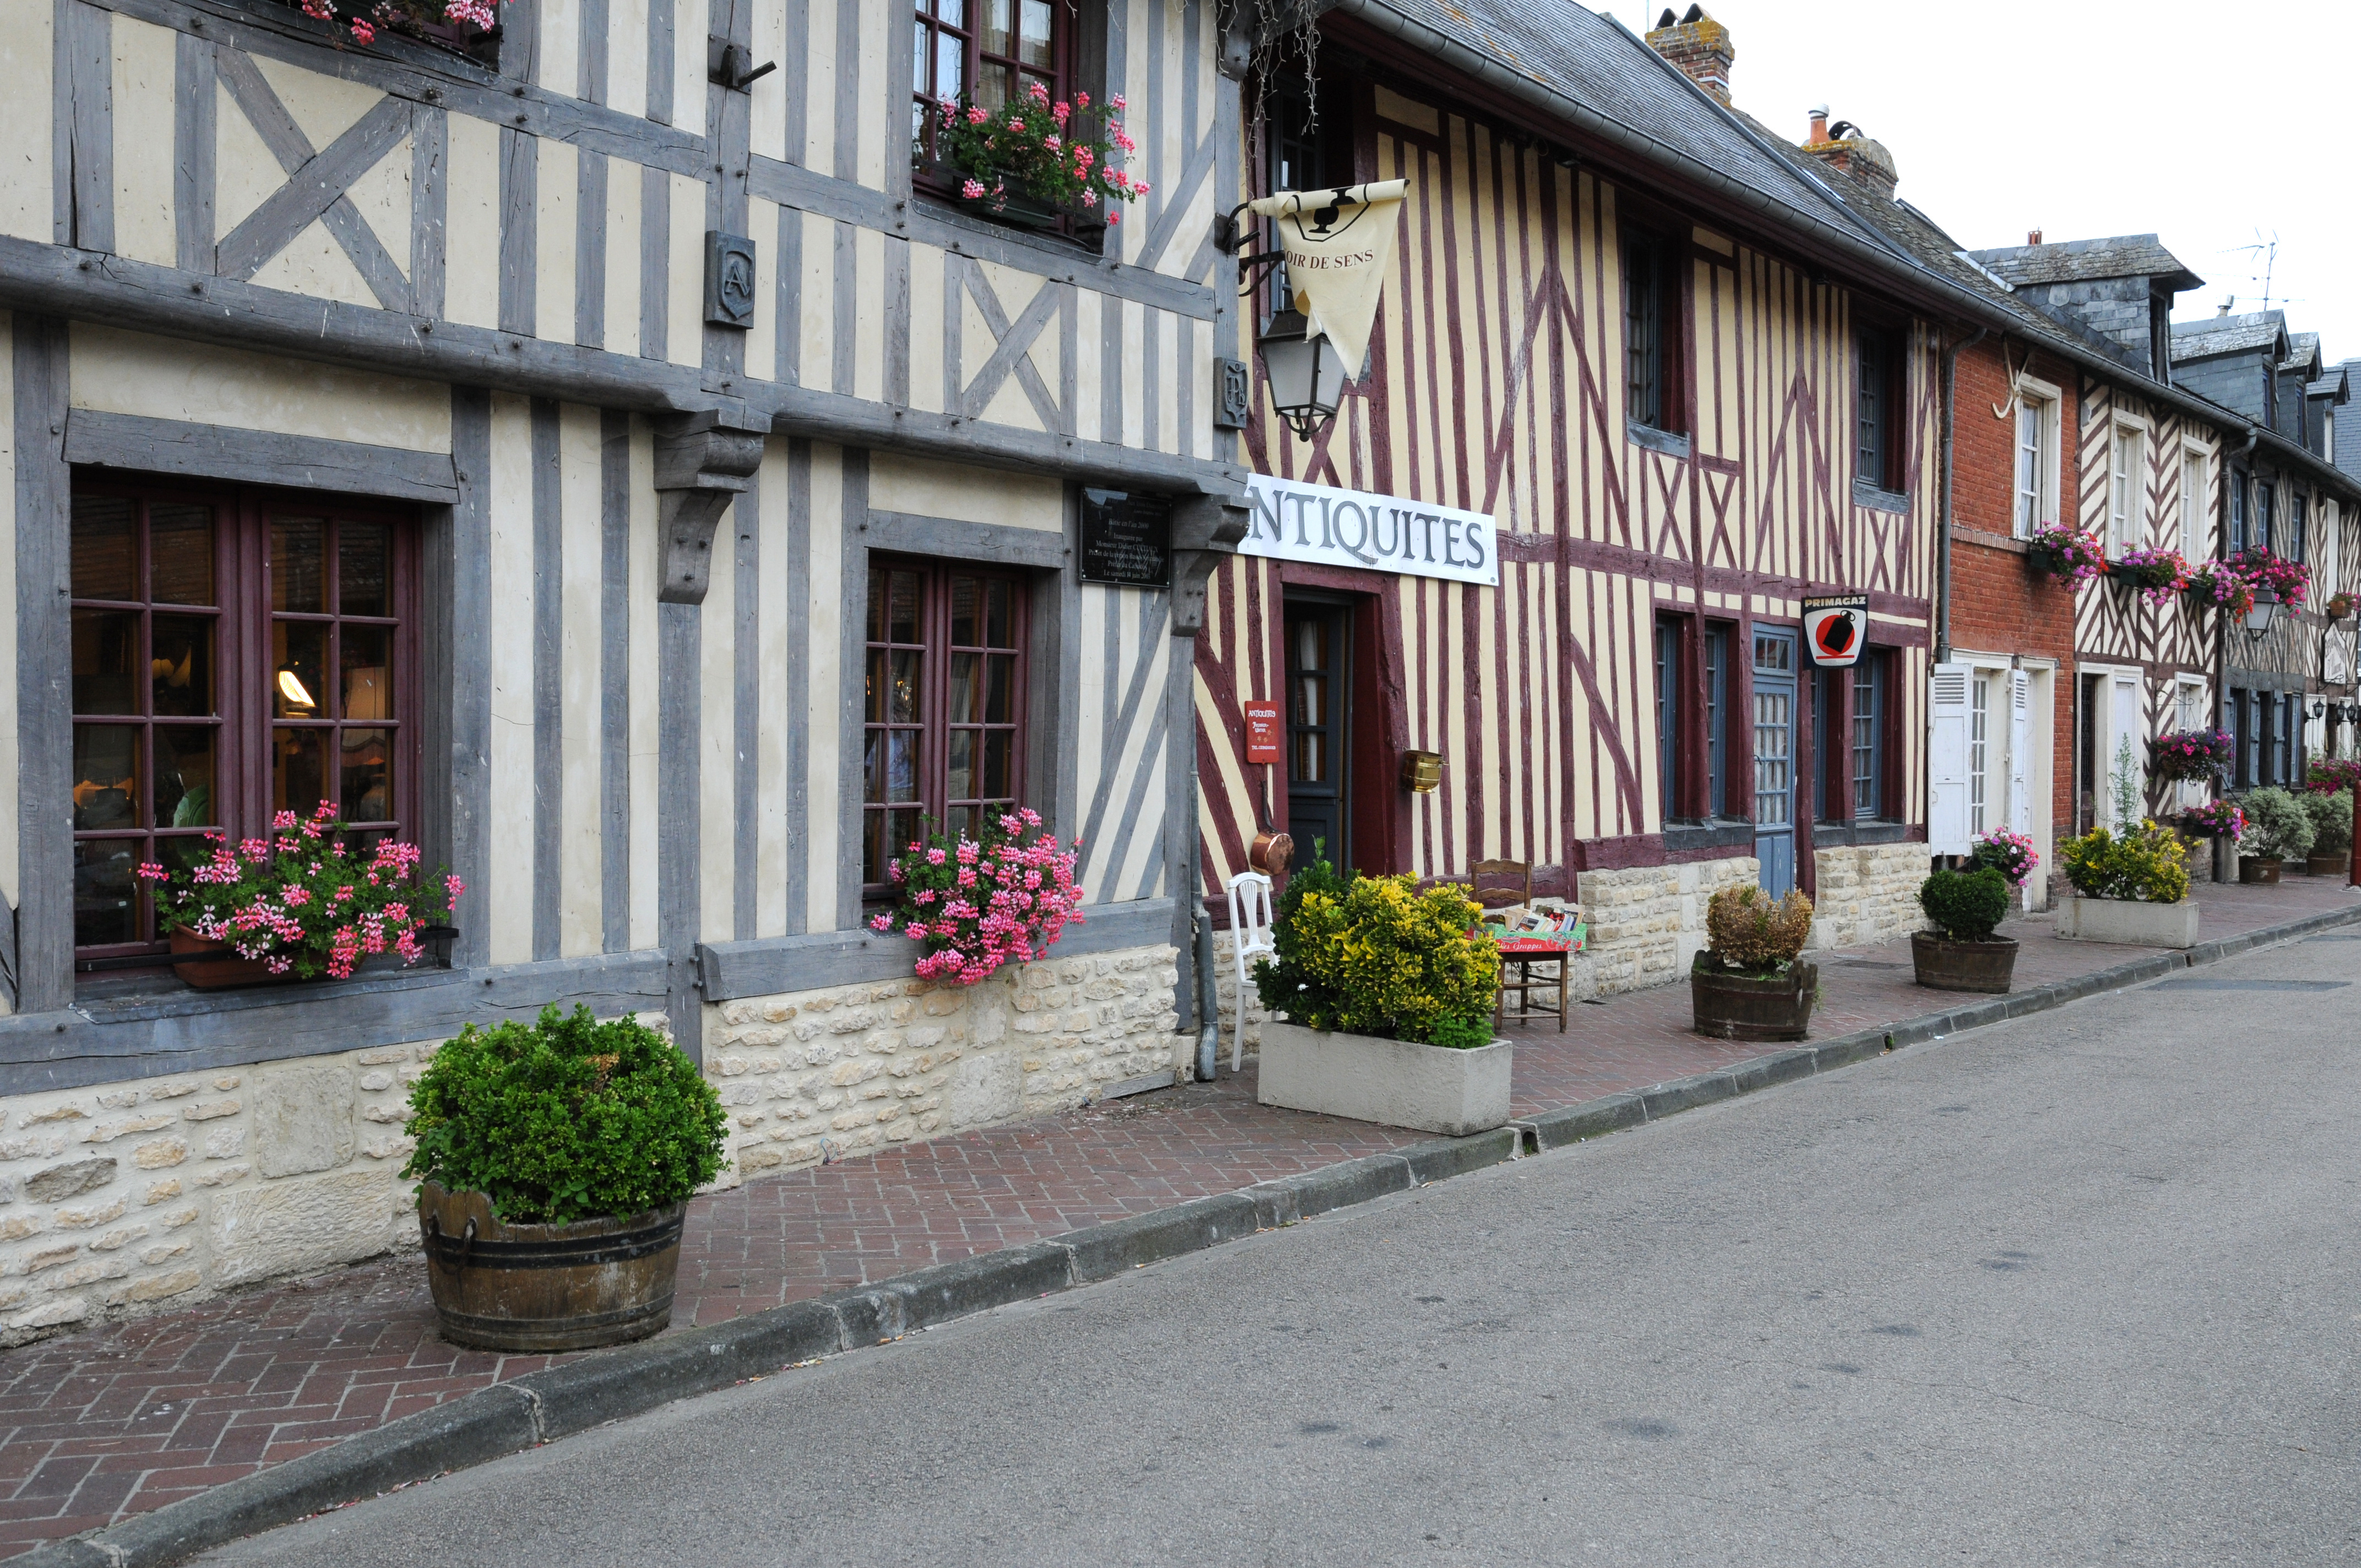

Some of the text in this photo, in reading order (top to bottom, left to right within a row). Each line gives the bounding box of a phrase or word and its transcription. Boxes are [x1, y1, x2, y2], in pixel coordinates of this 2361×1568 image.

[1285, 249, 1374, 269] OIR DE SENS
[1245, 486, 1486, 570] NTIQUITES
[1096, 540, 1117, 548] Monsieur
[1804, 596, 1866, 607] PRIMAGAZ
[1513, 942, 1543, 951] Grappes
